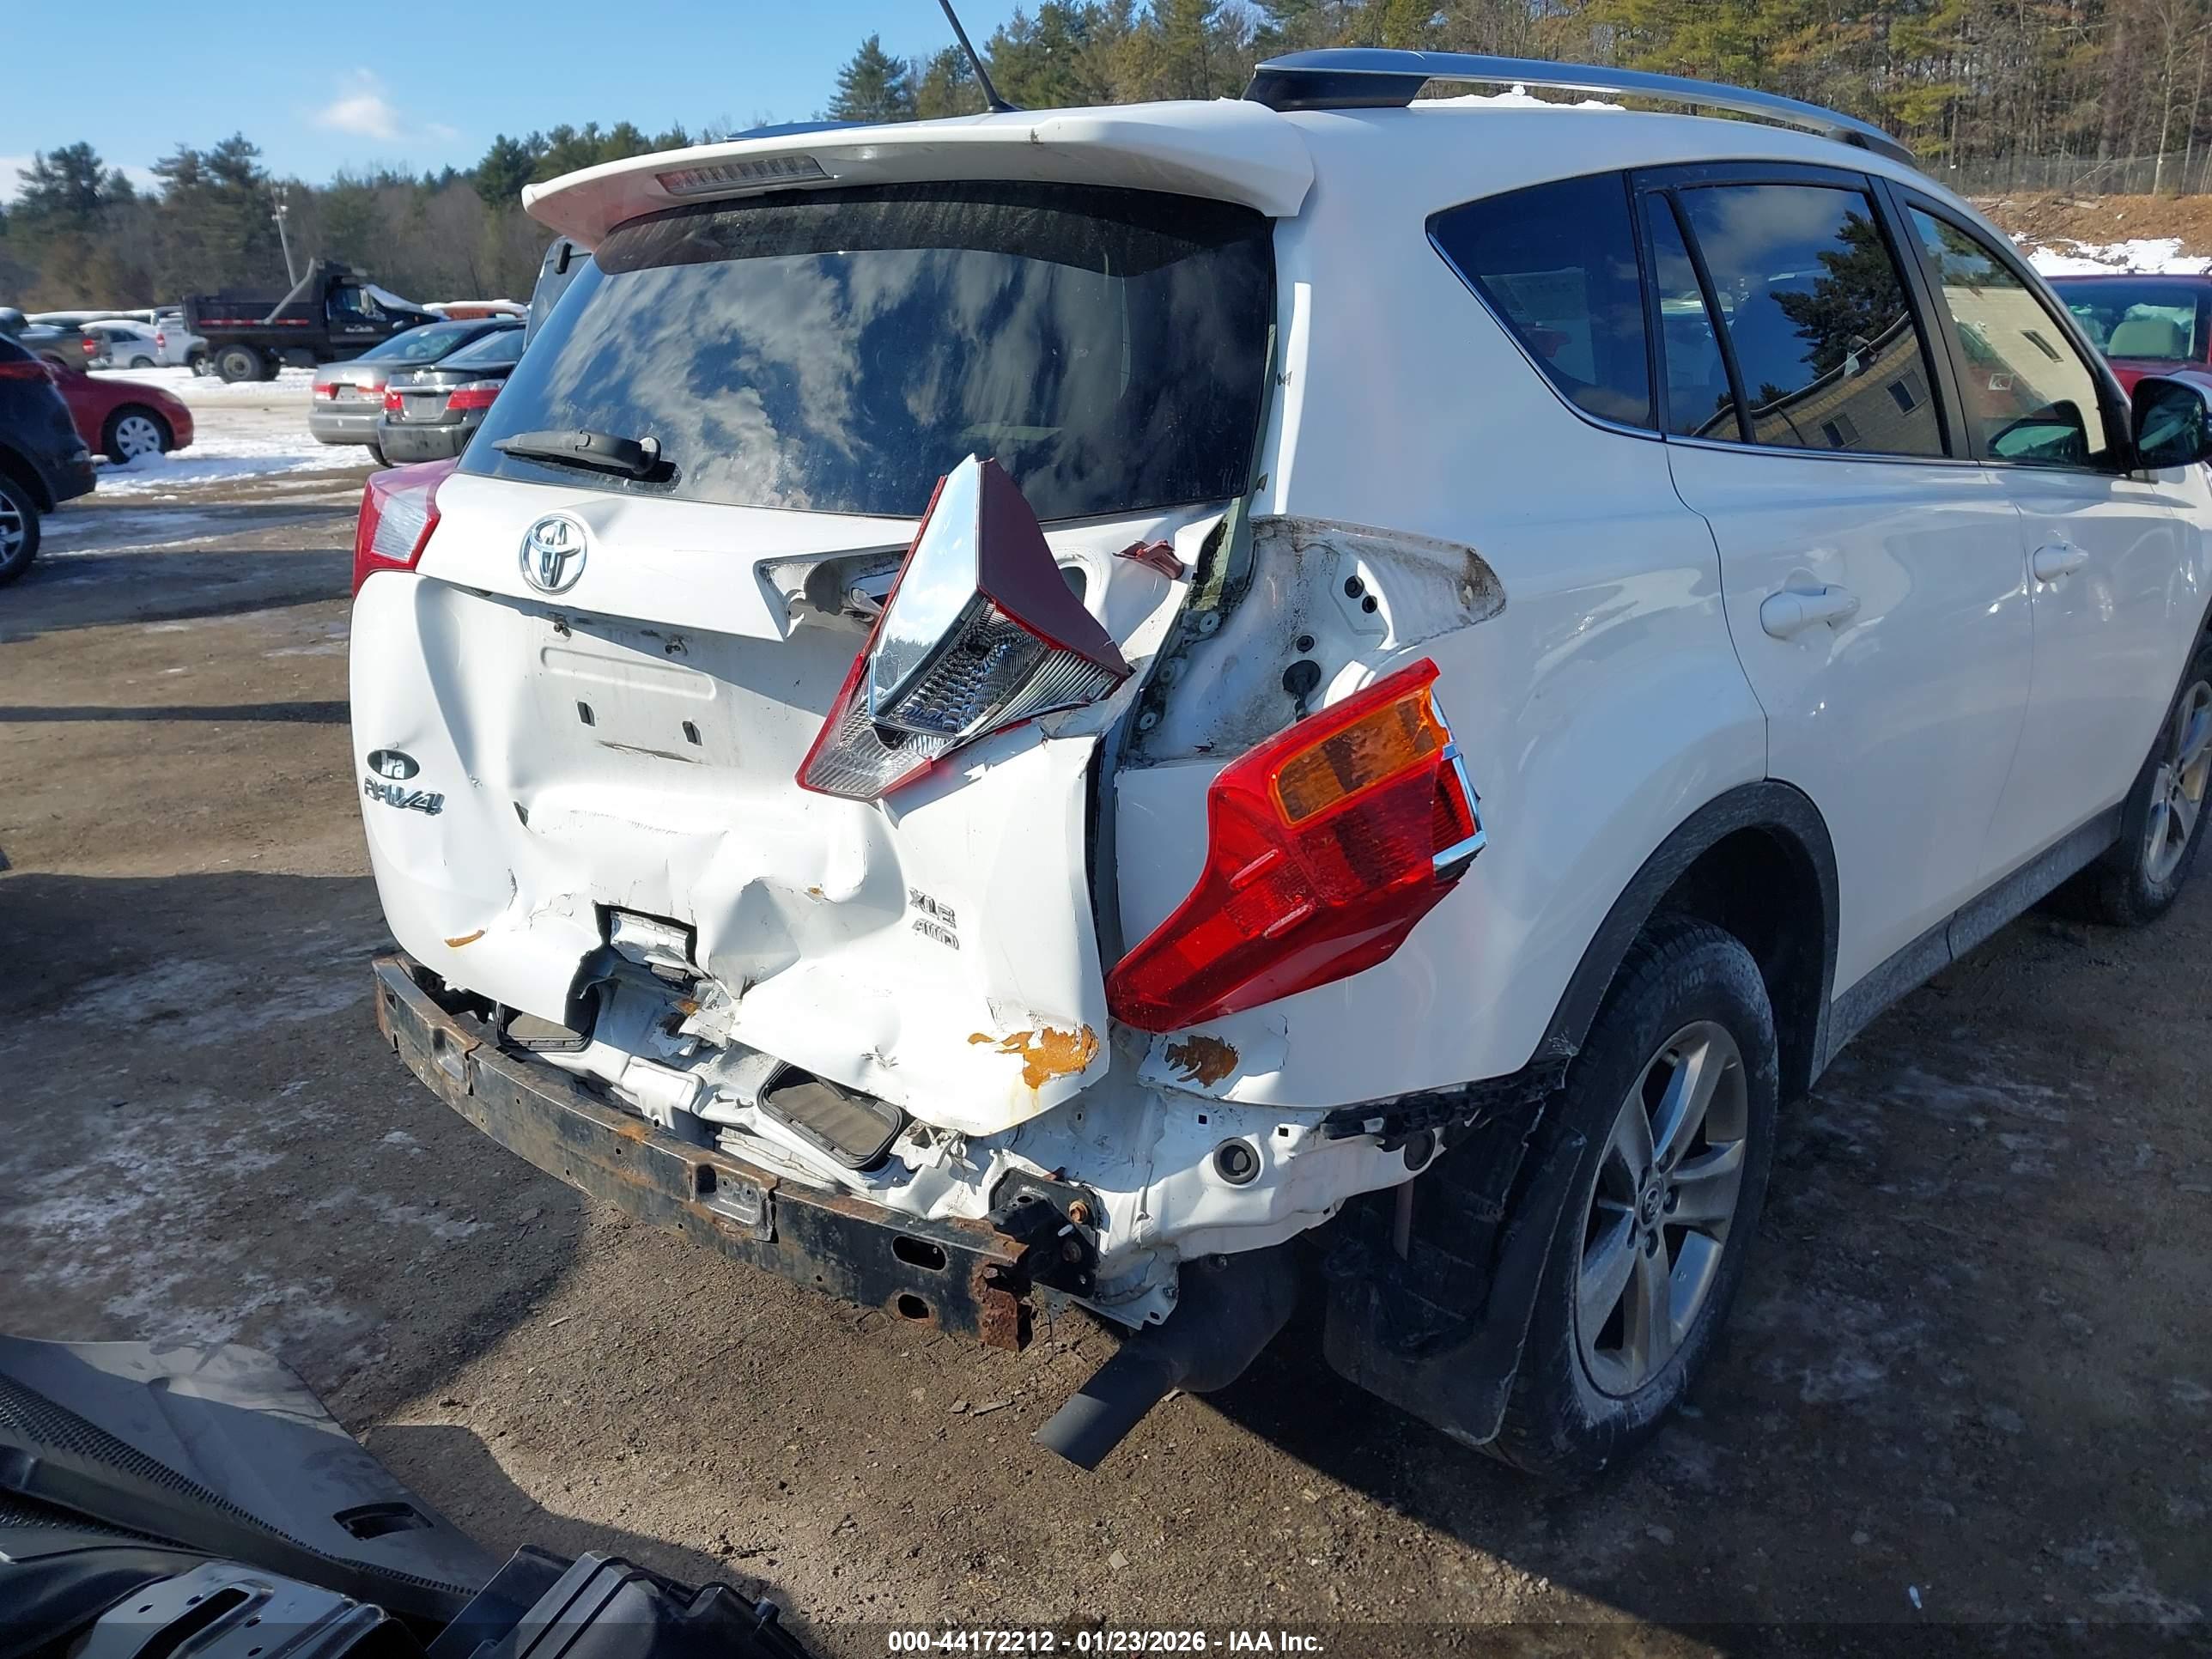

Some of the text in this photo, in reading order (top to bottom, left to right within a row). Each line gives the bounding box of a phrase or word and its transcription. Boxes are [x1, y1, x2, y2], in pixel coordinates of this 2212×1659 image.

[363, 775, 446, 816] RAV4
[908, 888, 957, 929] XLE
[911, 919, 960, 951] AWD
